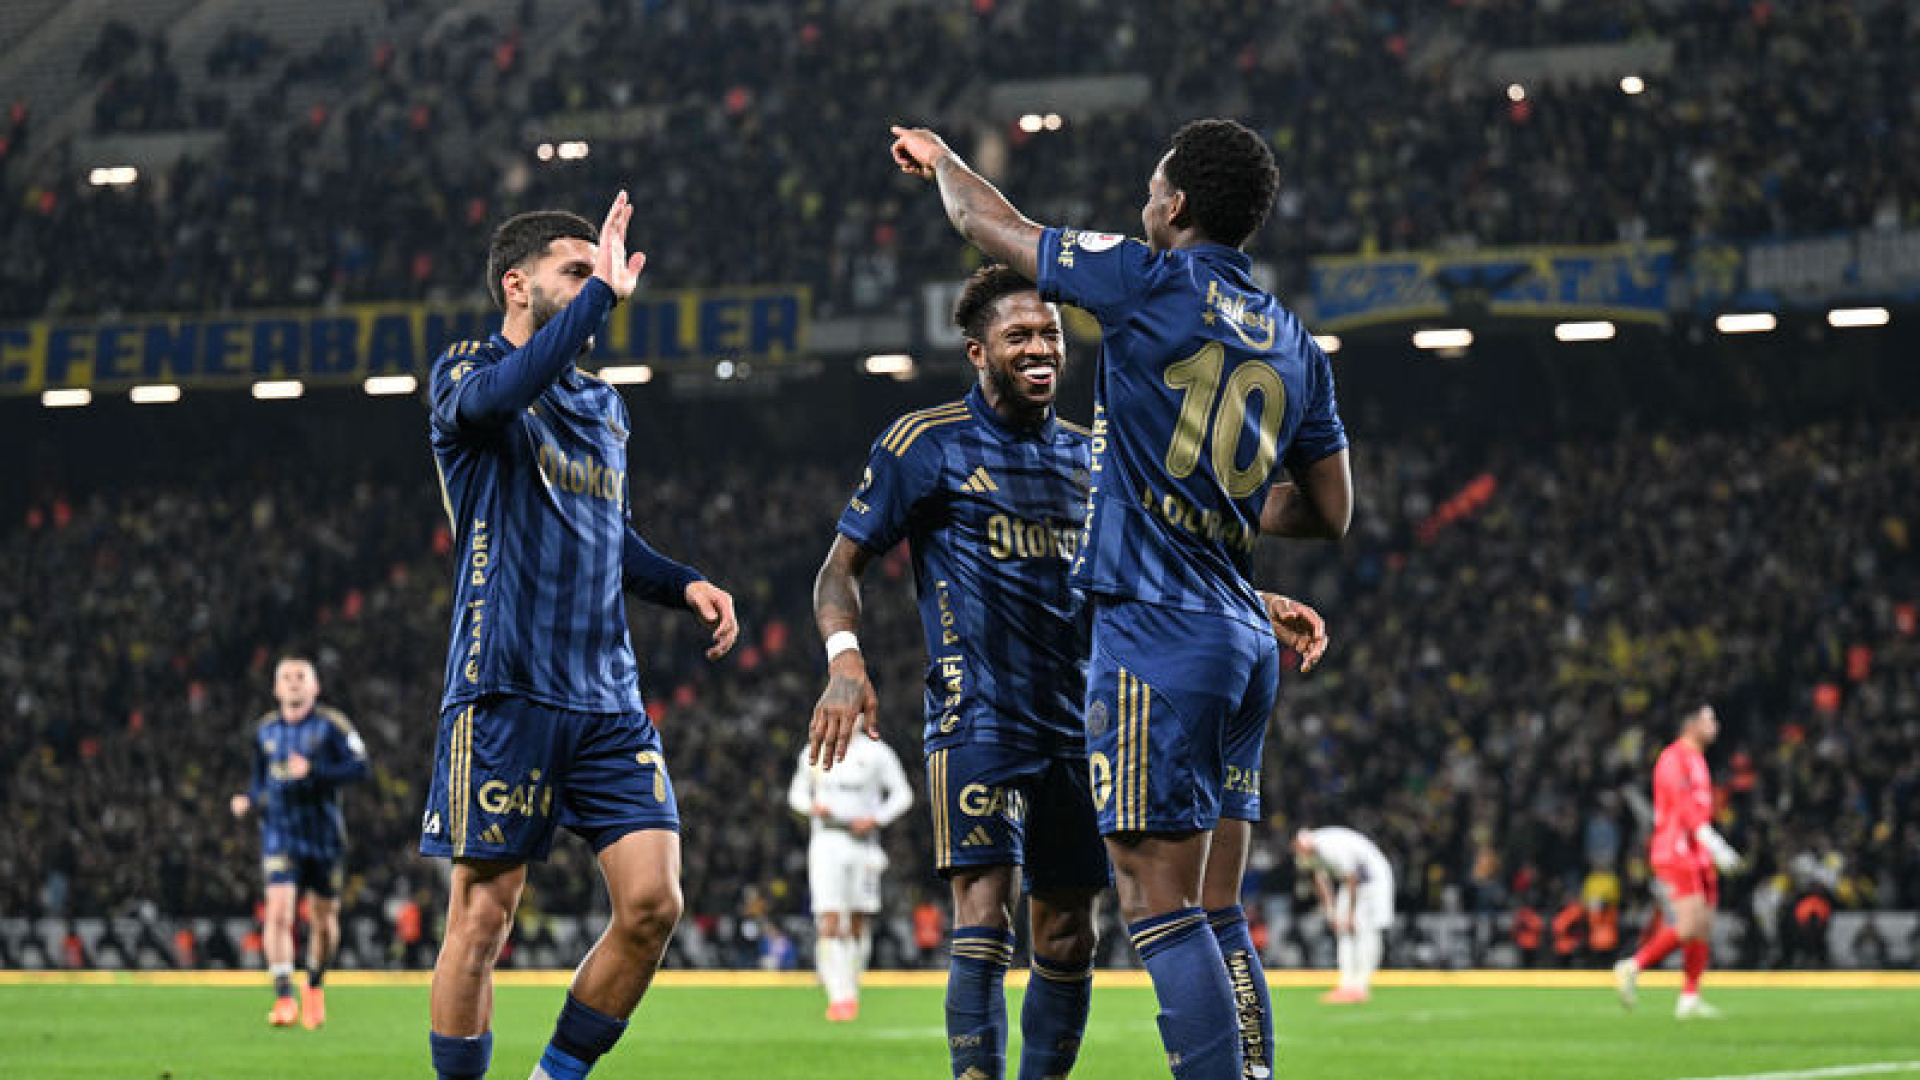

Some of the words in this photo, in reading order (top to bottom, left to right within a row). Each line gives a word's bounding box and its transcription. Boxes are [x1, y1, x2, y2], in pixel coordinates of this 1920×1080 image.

[1164, 341, 1286, 498] 10
[472, 518, 488, 586] PORT
[988, 513, 1077, 561] Otoko
[636, 750, 667, 803] 7
